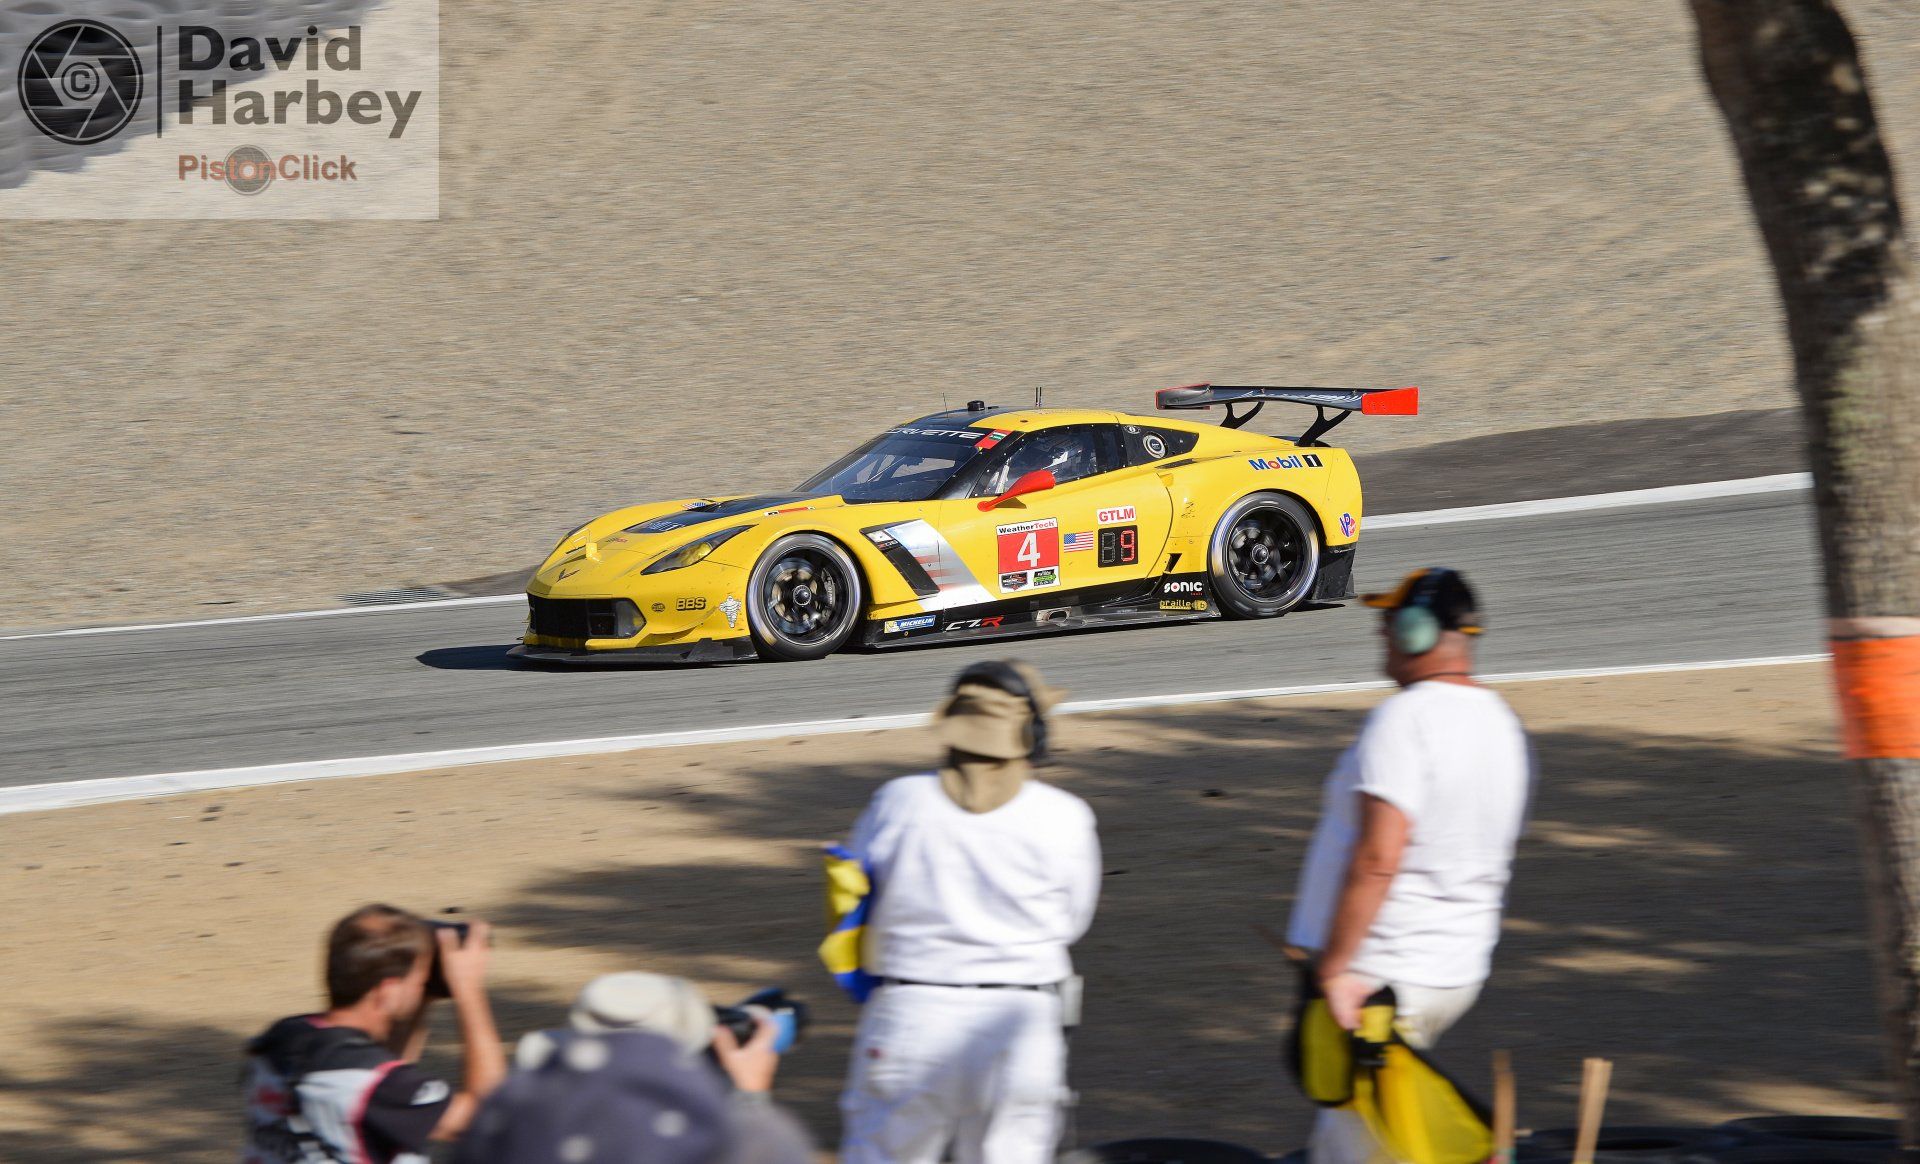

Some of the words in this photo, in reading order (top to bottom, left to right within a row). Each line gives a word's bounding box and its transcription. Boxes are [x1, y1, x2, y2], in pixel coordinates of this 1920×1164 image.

[1248, 455, 1303, 471] Mobil
[1305, 454, 1320, 468] 1
[1098, 508, 1135, 522] GTLM
[998, 520, 1055, 534] WeatherTech
[1017, 532, 1041, 567] 4
[676, 597, 706, 611] BBS
